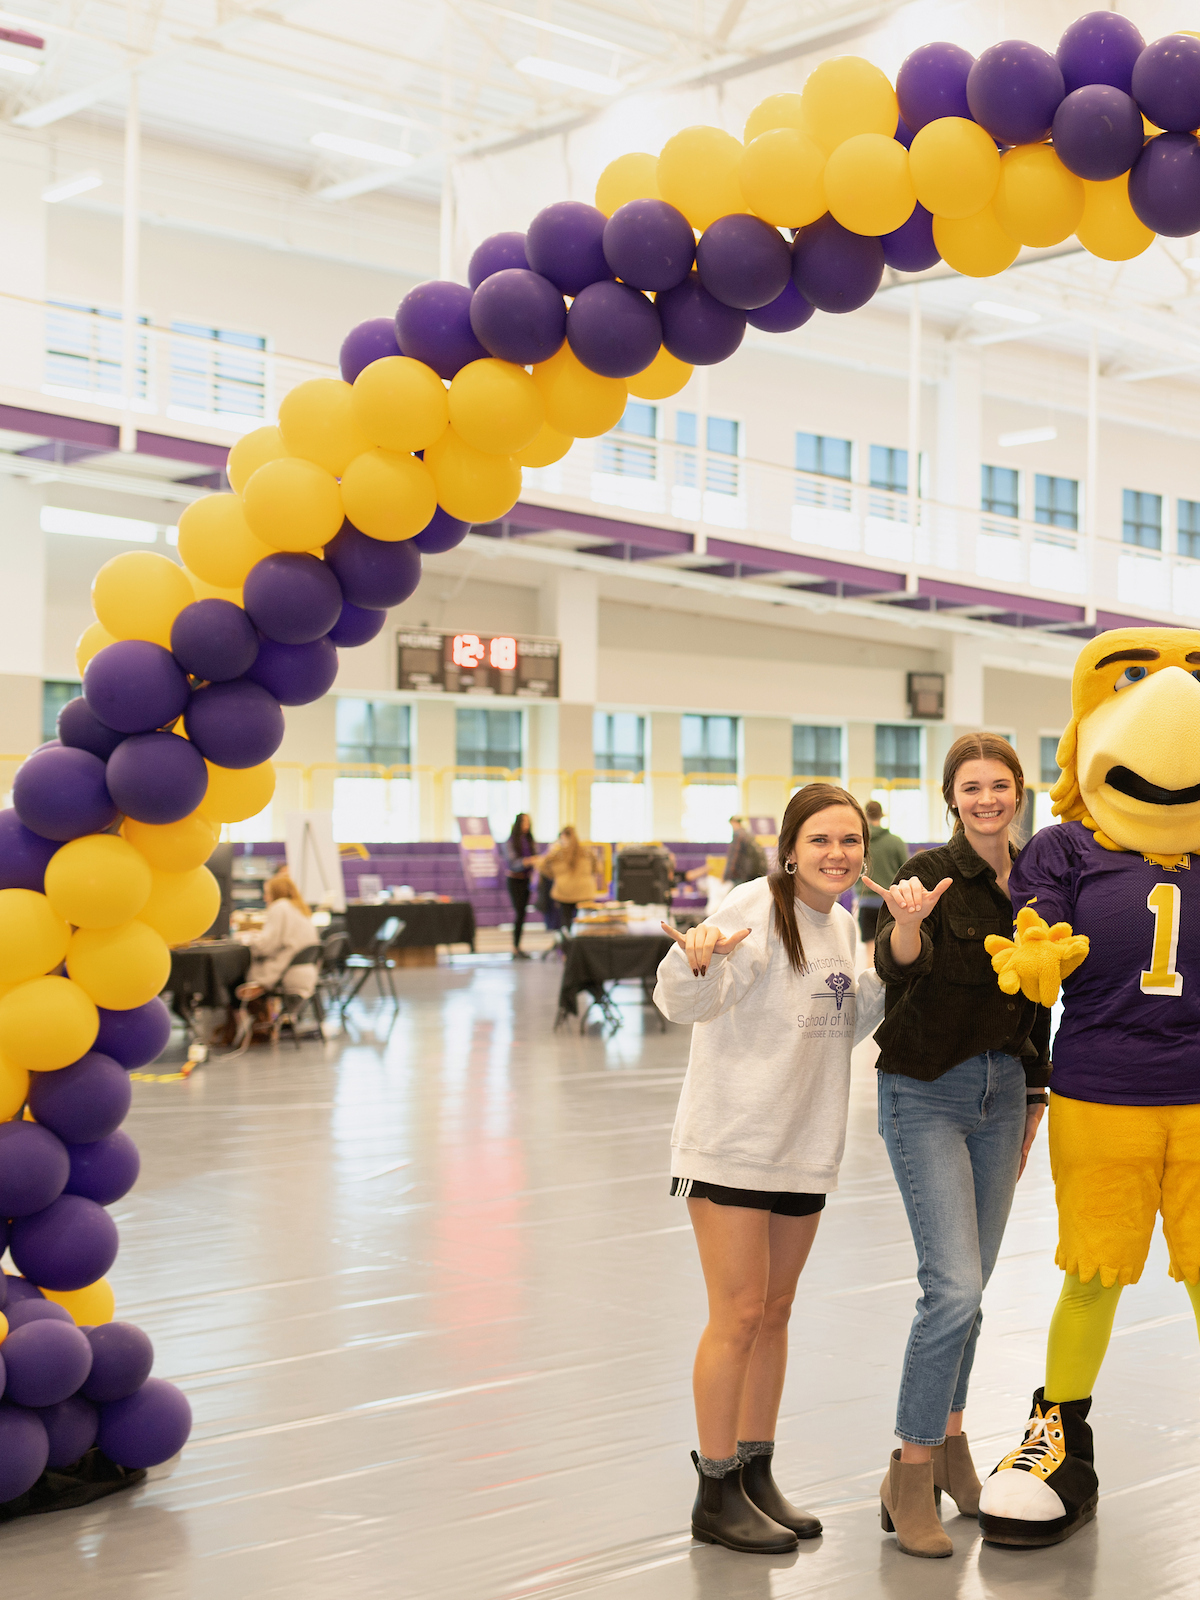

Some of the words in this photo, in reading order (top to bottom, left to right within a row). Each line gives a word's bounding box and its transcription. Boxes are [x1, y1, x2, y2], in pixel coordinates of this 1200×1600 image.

[453, 634, 517, 670] 12:18
[1139, 883, 1183, 997] 1
[797, 1013, 828, 1029] School
[830, 1013, 842, 1026] of
[828, 1030, 844, 1039] TECH
